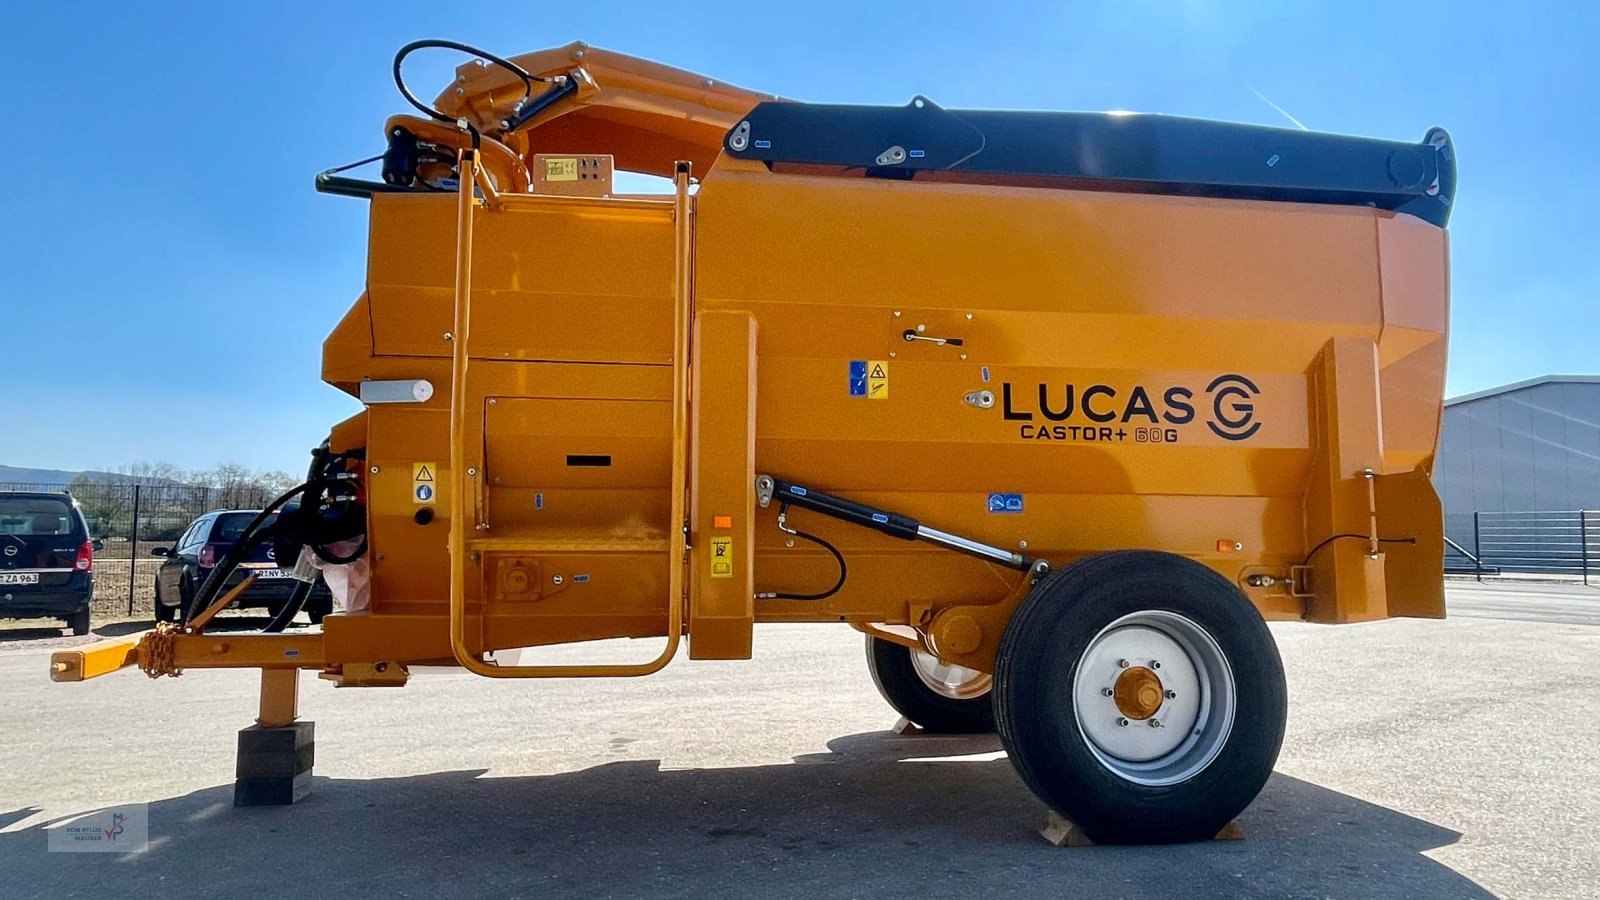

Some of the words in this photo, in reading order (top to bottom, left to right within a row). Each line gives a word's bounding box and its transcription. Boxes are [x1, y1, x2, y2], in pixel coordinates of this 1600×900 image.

[1003, 382, 1196, 425] LUCAS
[1020, 425, 1127, 441] CASTOR+
[1135, 427, 1178, 443] 60G
[5, 574, 18, 583] ZA
[20, 574, 38, 583] 963
